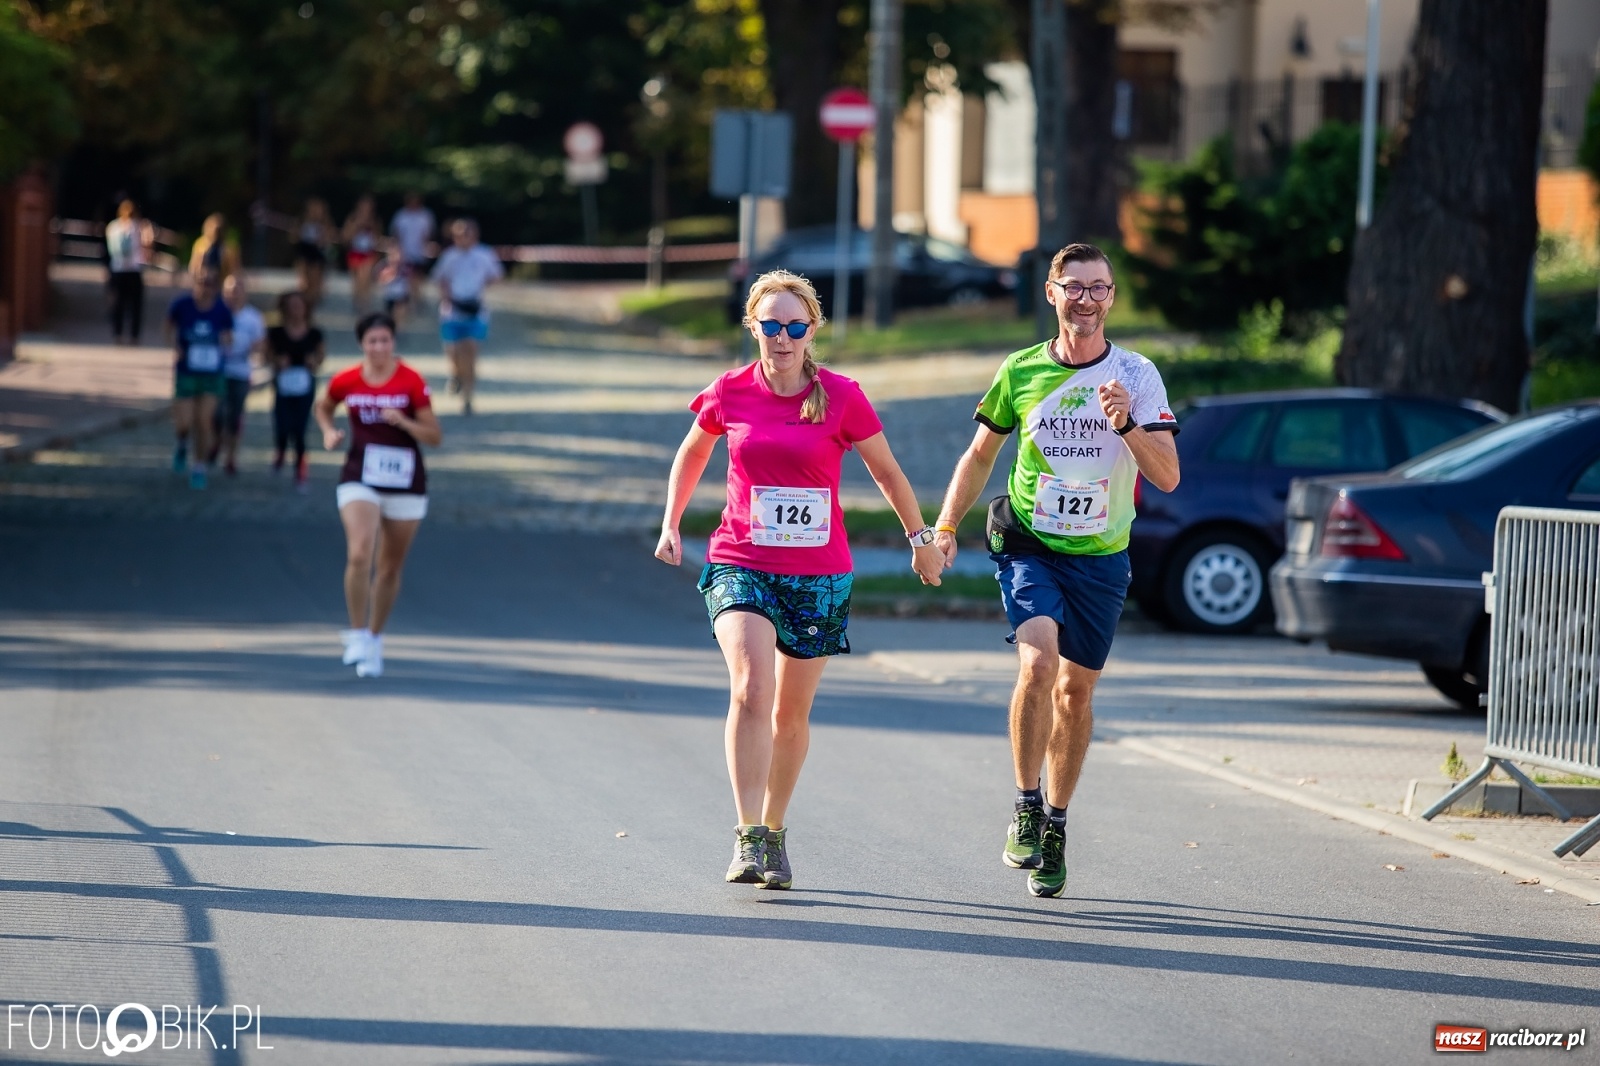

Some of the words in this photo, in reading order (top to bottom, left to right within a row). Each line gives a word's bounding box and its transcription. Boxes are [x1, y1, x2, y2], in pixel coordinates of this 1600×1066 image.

[1038, 418, 1108, 432] AKTYWNI
[1053, 430, 1095, 440] LYSKI
[1043, 446, 1103, 458] GEOFART
[1057, 494, 1094, 516] 127
[774, 504, 812, 526] 126
